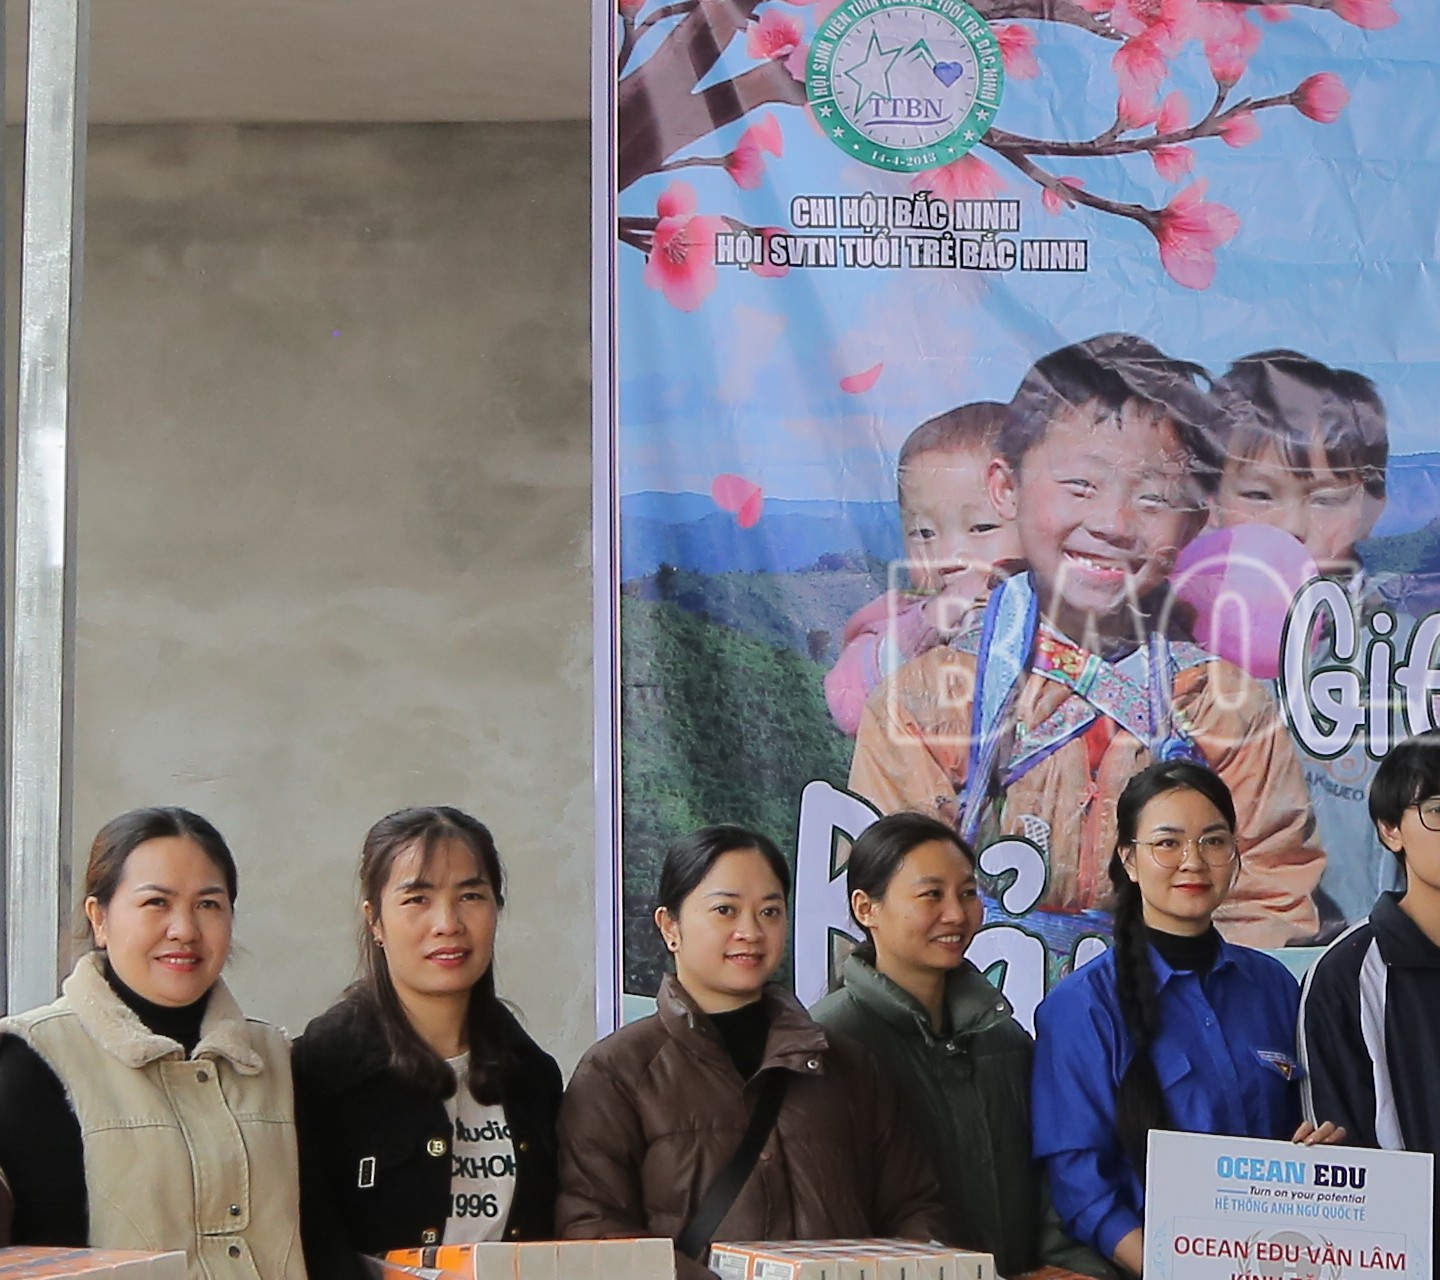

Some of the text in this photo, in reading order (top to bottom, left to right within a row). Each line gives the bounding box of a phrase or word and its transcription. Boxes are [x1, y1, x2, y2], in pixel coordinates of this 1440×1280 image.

[813, 40, 833, 72] SINH
[868, 97, 944, 119] TTBN
[791, 191, 1020, 233] CHI HỘI BẮC NINH
[715, 228, 1087, 272] HỘI SVTN TUỔI TRẺ BẮC NINH
[1217, 1155, 1367, 1189] OCEAN EDU
[1215, 1196, 1366, 1222] HỆ THỐNG ANH NGỮ QUỐC TẾ
[1250, 1186, 1366, 1204] Turn on your potential
[1173, 1236, 1406, 1271] OCEAN EDU VĂN LÂM
